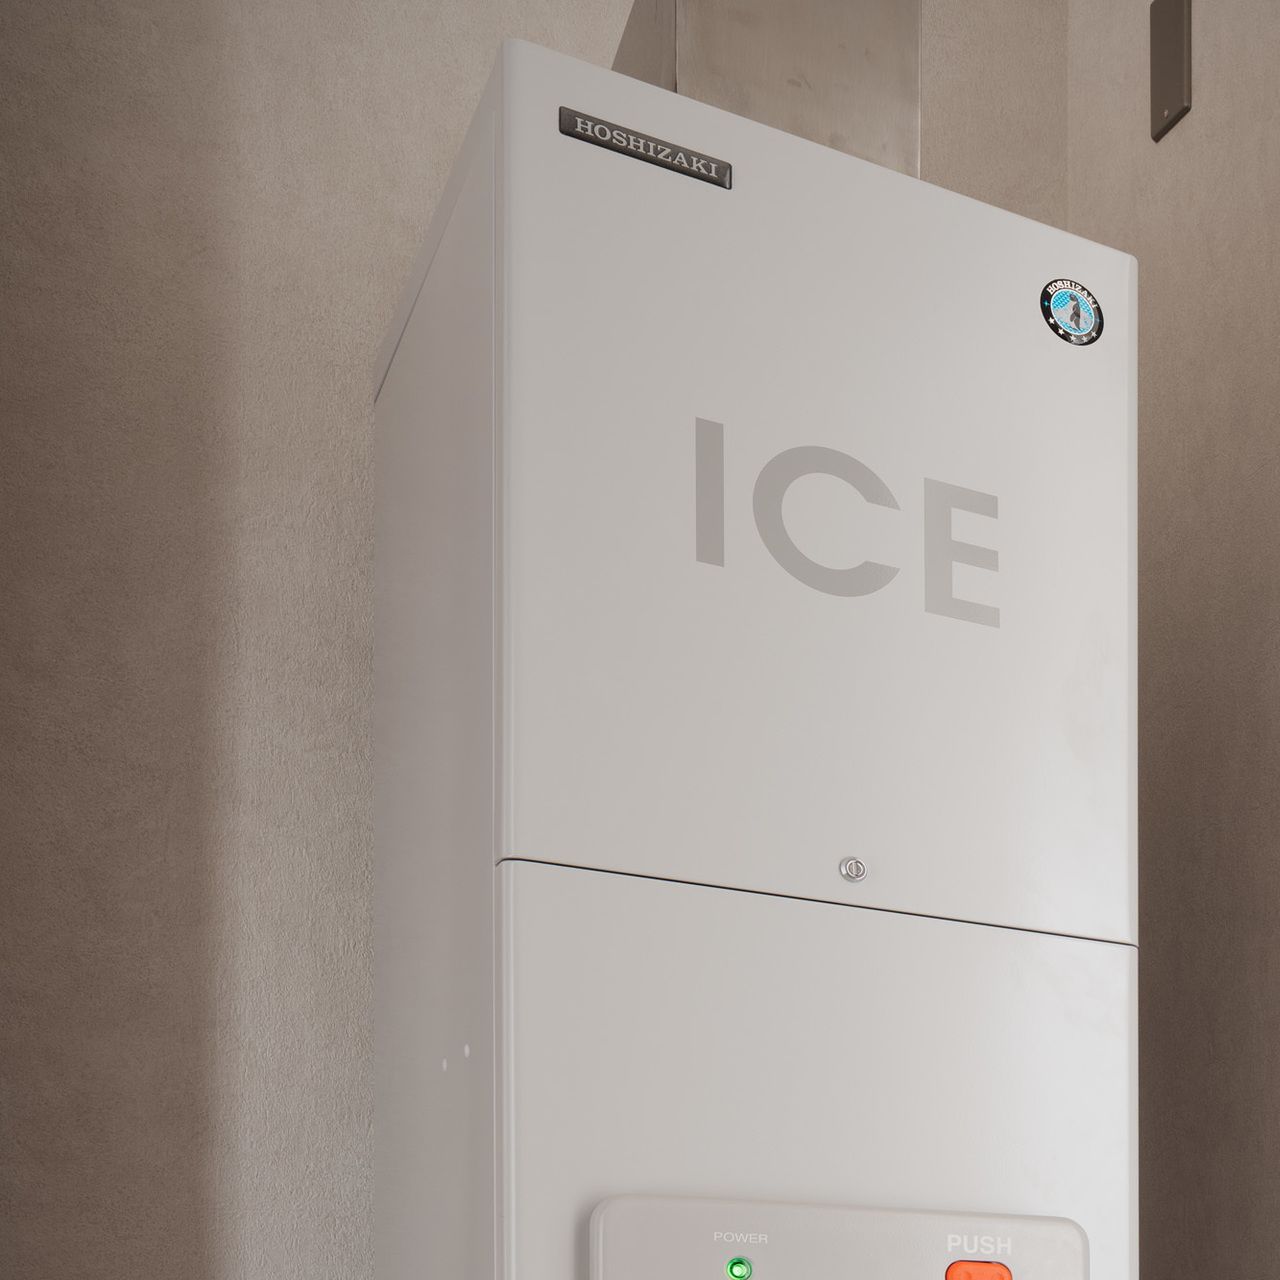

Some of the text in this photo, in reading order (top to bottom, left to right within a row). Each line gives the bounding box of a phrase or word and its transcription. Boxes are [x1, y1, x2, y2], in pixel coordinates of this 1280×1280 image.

[575, 117, 718, 178] HOSHIZAKI
[1046, 280, 1098, 309] HOSHIZAKI
[695, 416, 1000, 629] ICE
[713, 1231, 769, 1245] POWER
[946, 1234, 1012, 1256] PUSH
